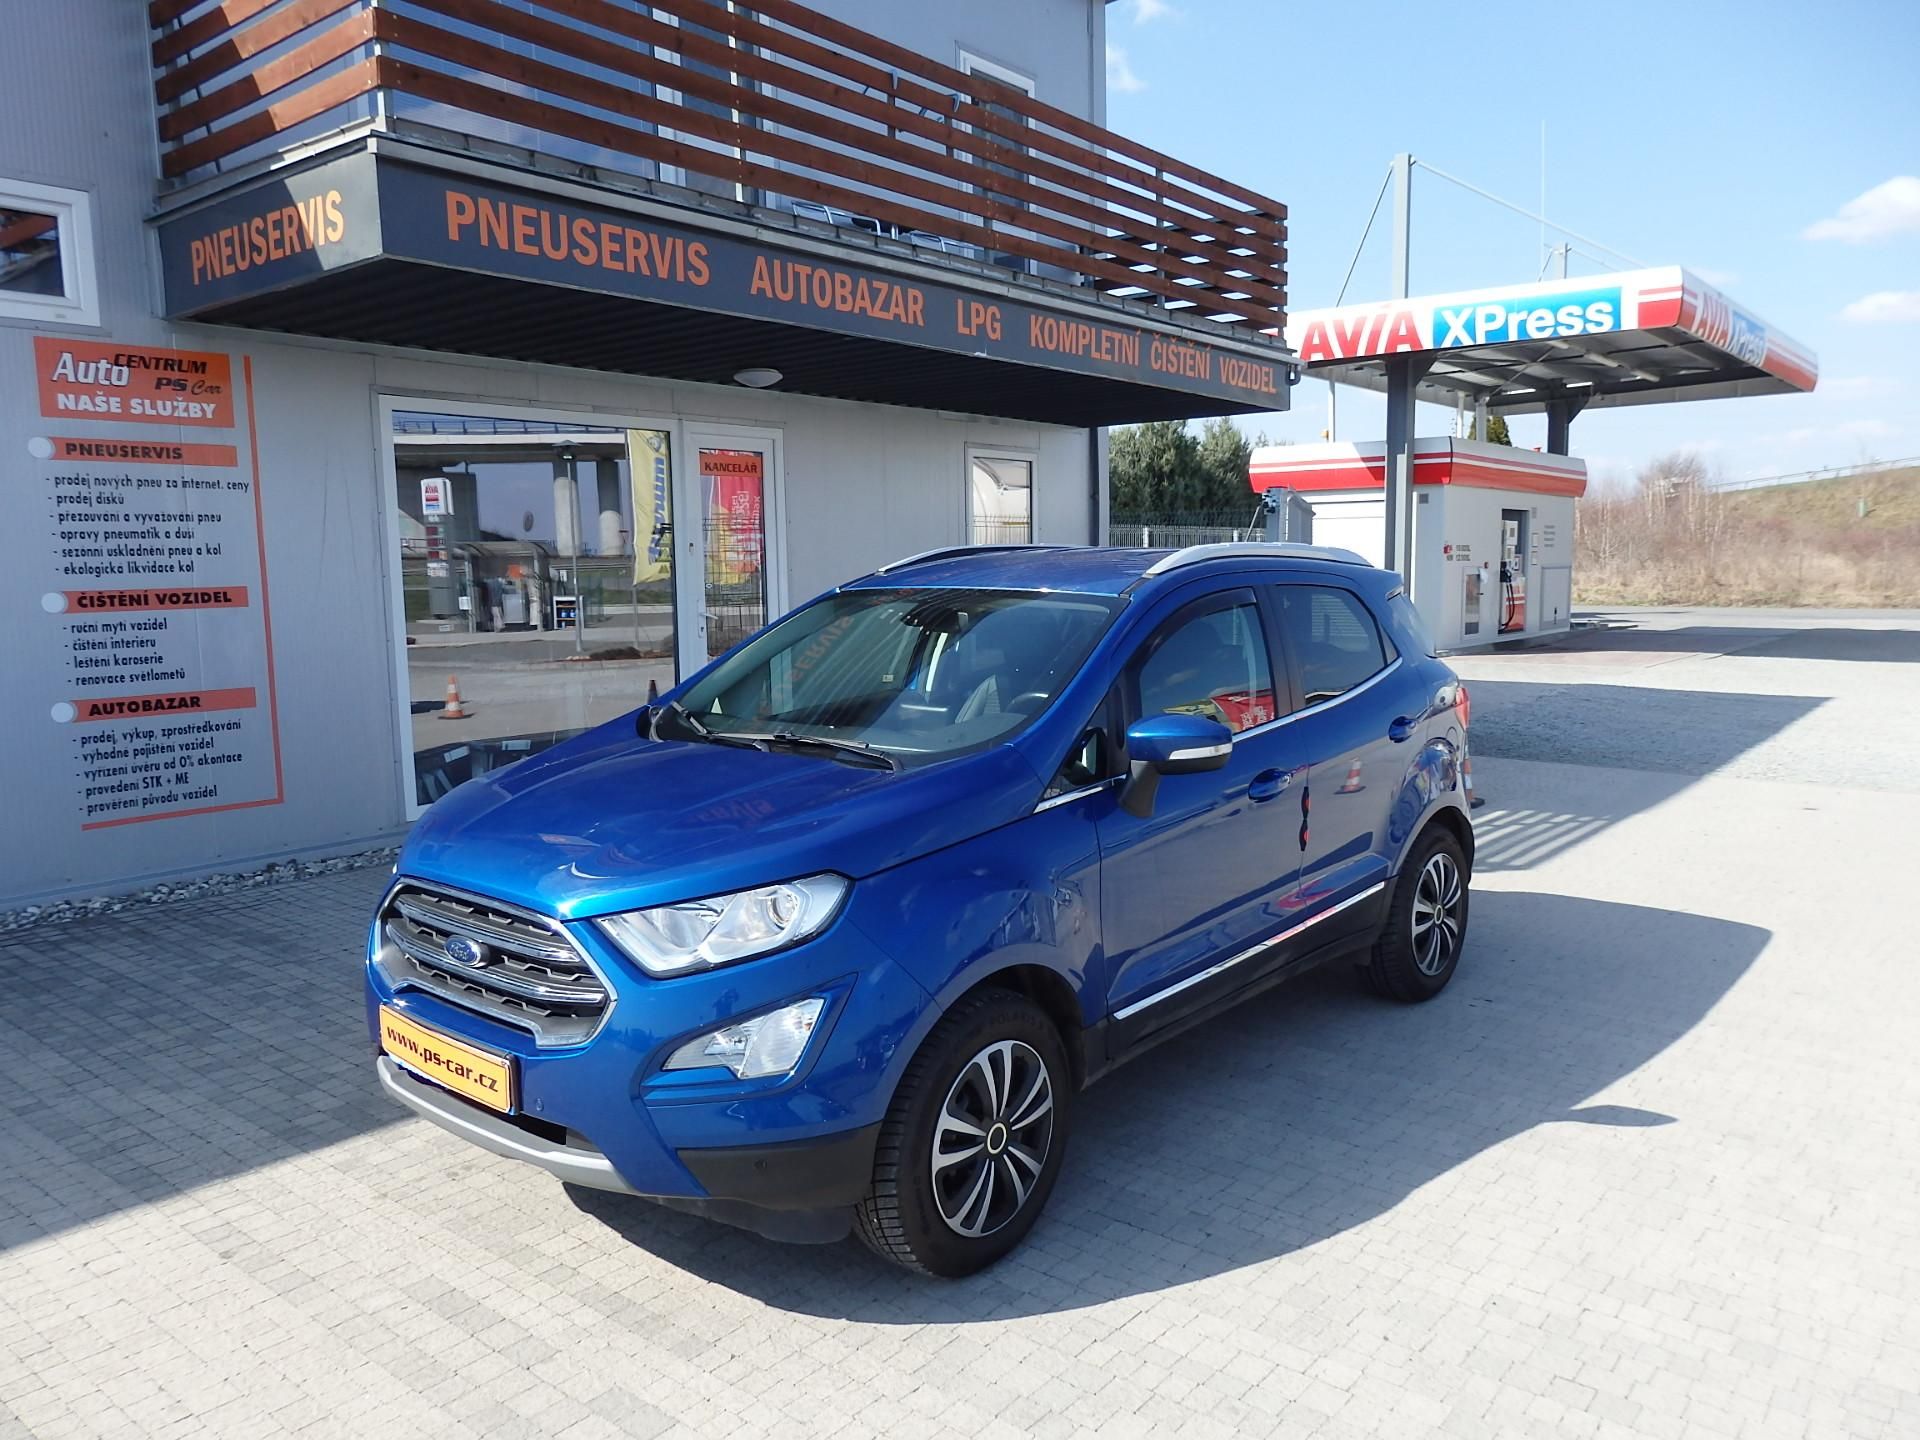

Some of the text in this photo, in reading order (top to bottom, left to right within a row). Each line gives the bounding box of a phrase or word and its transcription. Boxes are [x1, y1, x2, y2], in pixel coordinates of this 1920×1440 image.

[190, 189, 345, 286] PNEUSERVIS
[445, 189, 1277, 394] PNEUSERVIS AUTOBAZAR LPG KOMPLETNÍ ČIŠTĚNÍ VOZIDEL
[1299, 300, 1614, 361] AVIA XPress
[52, 352, 208, 387] Auto CENTRUM
[154, 376, 223, 396] PS Car
[57, 391, 217, 419] NAŠE SLUŽBY
[65, 443, 183, 459] PNEUSERVIS
[704, 461, 758, 474] KANCELÁŘ
[54, 473, 249, 493] prodej nových pneu za internet. ceny
[56, 492, 92, 507] prodej
[58, 510, 221, 525] přezouvání a vyvažování pneu
[60, 530, 99, 543] opravy
[104, 527, 161, 542] pneumatik
[165, 530, 171, 540] a
[107, 544, 165, 557] uskladnění
[168, 546, 193, 559] pneu
[196, 546, 203, 556] a
[206, 543, 222, 556] kol
[64, 560, 194, 578] ekologická likvidace kol
[77, 590, 232, 608] ČIŠTĚNÍ VOZIDEL
[71, 622, 98, 634] ruční
[130, 618, 167, 631] vozidel
[73, 636, 156, 651] čištění interiéru
[74, 652, 163, 668] leštění karoserie
[76, 667, 186, 686] renovace světlometů
[89, 696, 201, 717] AUTOBAZAR
[161, 719, 241, 739] zprostředkování
[133, 742, 176, 758] pojištění
[178, 737, 214, 752] vozidel
[164, 756, 176, 770] od
[179, 754, 195, 768] 0%
[197, 752, 242, 766] akontace
[86, 779, 139, 799] provedení
[142, 774, 163, 789] STK
[175, 772, 189, 785] ME
[87, 785, 218, 817] prověření původu vozidel
[386, 1025, 499, 1093] www.ps-car.cz
